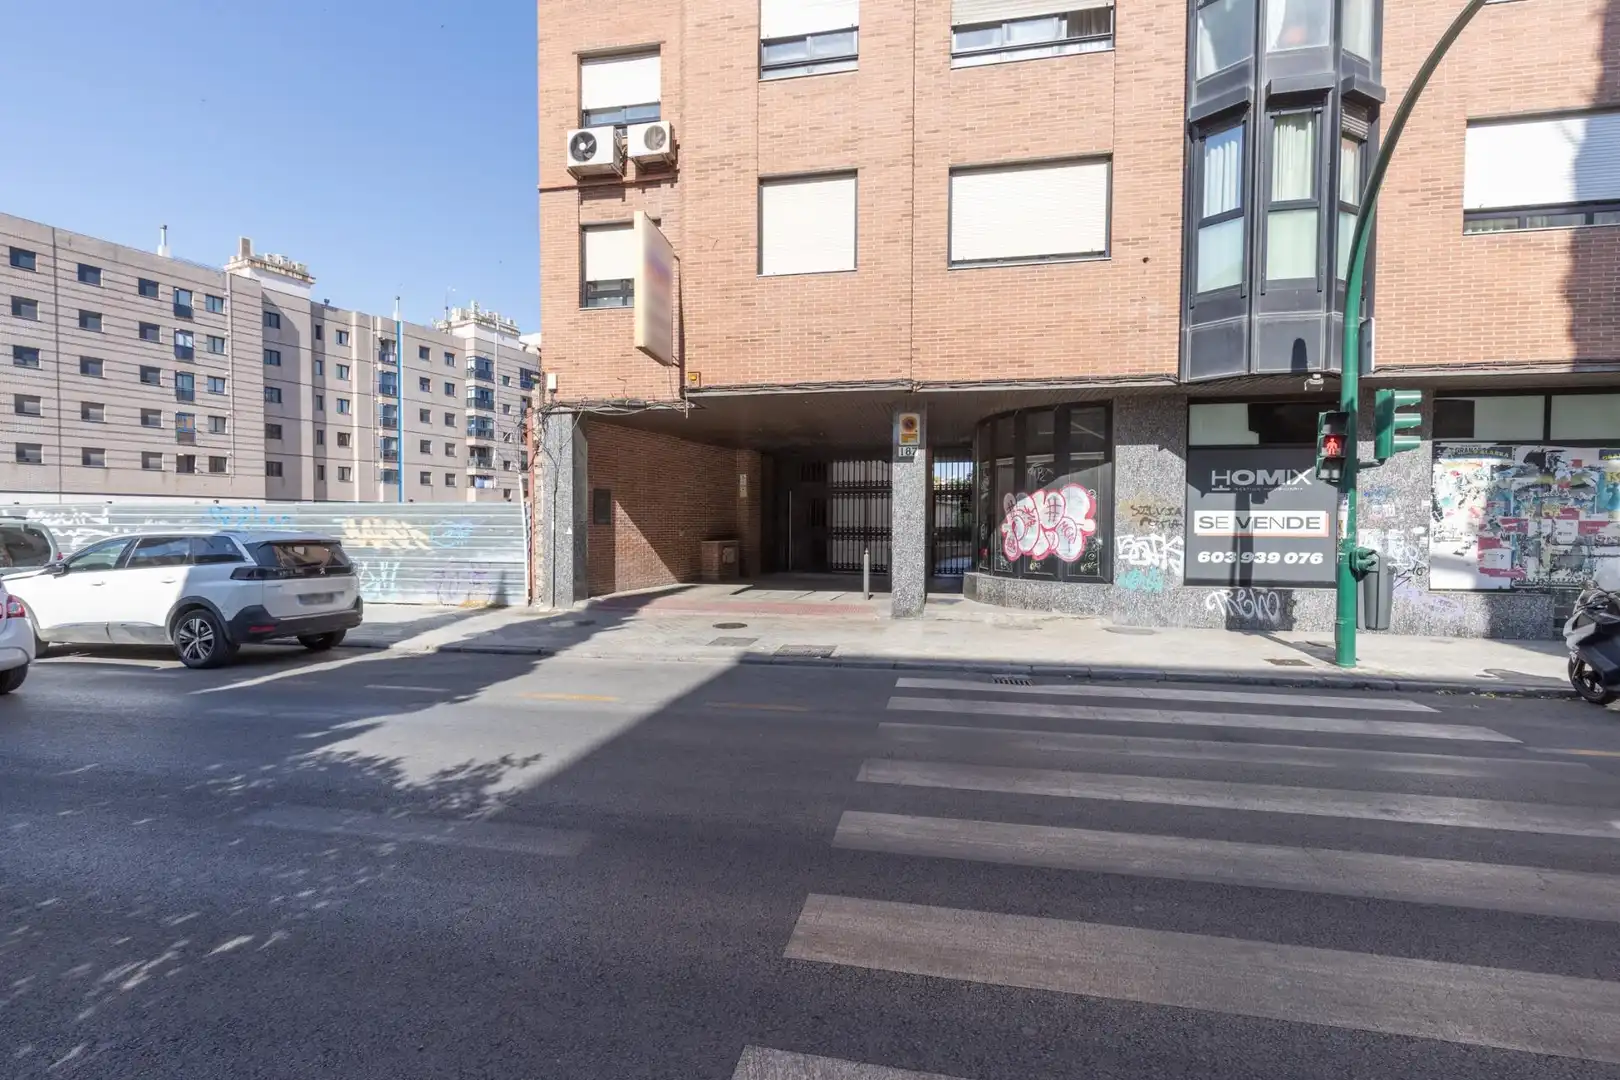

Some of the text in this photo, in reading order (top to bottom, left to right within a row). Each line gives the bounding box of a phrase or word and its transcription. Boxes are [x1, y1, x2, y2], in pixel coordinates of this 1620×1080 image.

[901, 447, 917, 456] 187
[1211, 469, 1312, 486] HOMIX
[1199, 516, 1321, 530] SE VENDE
[1198, 551, 1324, 565] 603 939 076
